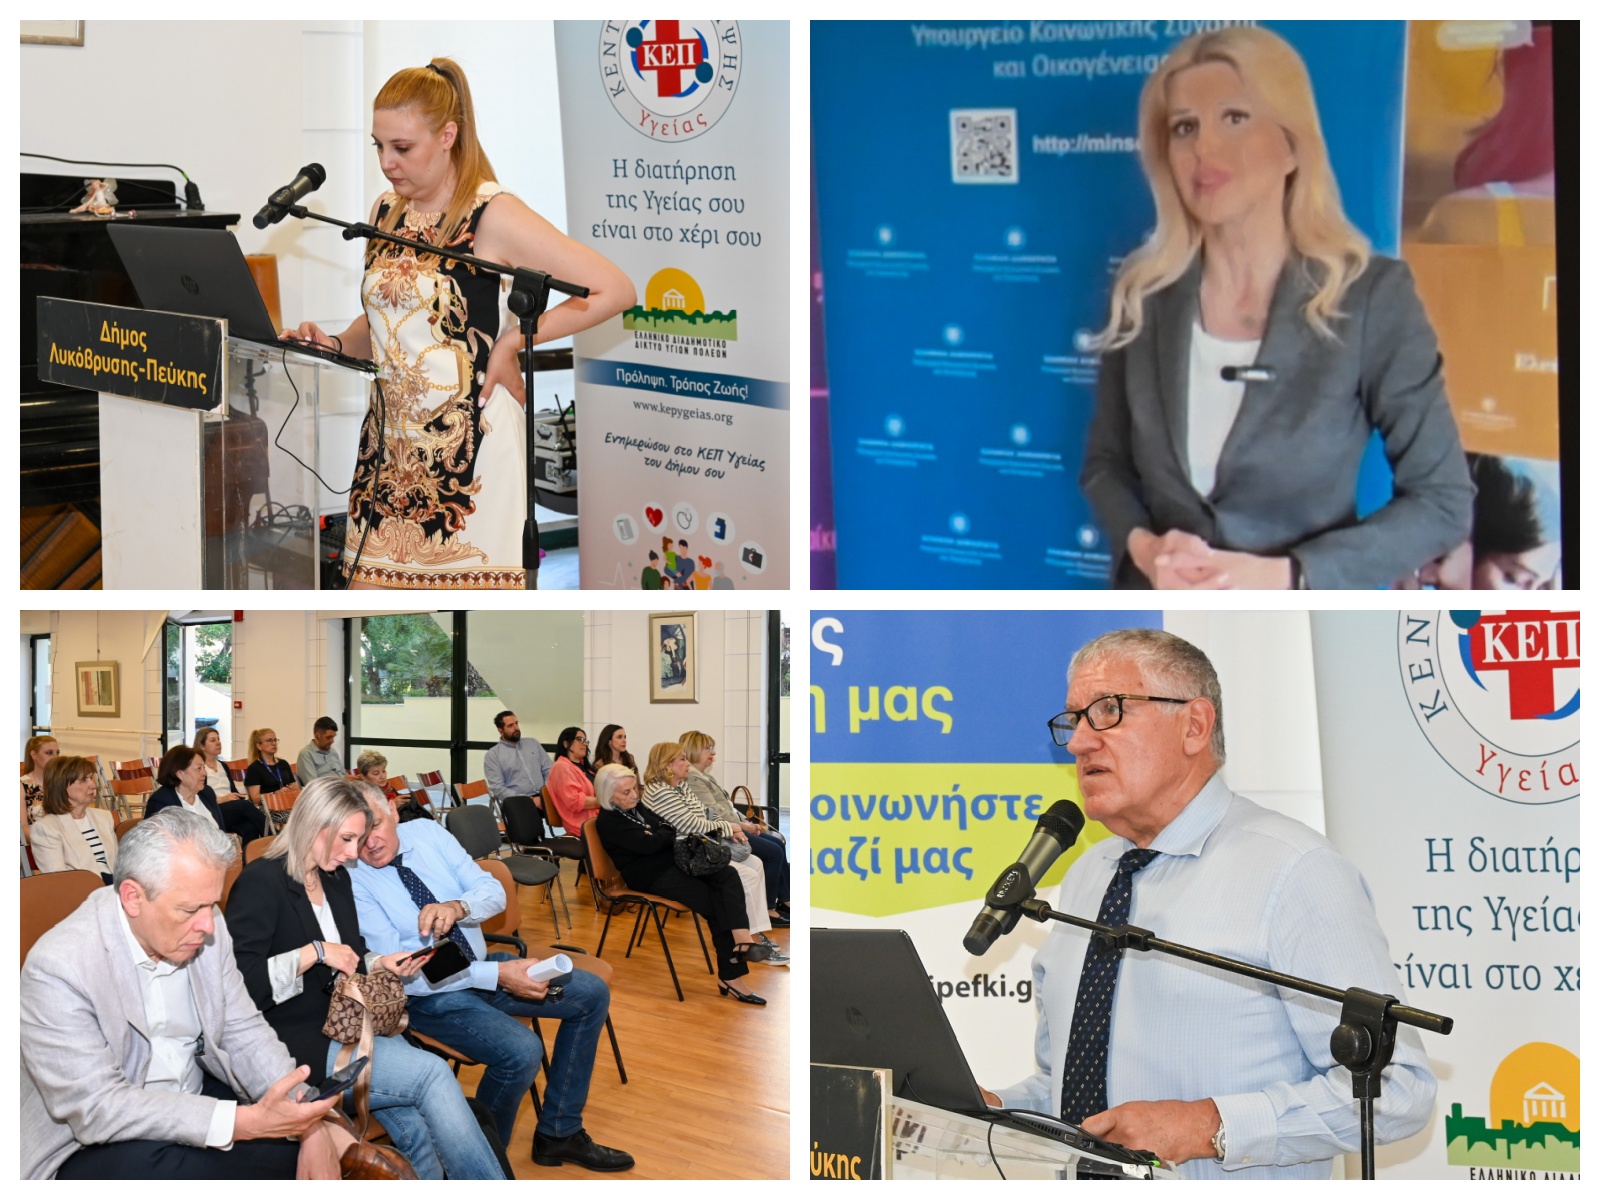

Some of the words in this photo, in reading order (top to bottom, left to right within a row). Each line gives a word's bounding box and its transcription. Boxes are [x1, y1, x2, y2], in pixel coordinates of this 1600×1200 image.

[911, 22, 1025, 51] Υπουργείο
[642, 43, 696, 67] ΚΕΠ
[993, 60, 1026, 78] και
[1032, 51, 1169, 80] Οικογένεια
[639, 110, 707, 136] Υγείας
[612, 159, 628, 178] Η
[634, 158, 736, 185] διατήρηση
[606, 194, 637, 211] της
[643, 190, 702, 215] Υγείας
[709, 197, 745, 213] σου
[592, 219, 637, 240] είναι
[643, 226, 673, 242] στο
[680, 223, 719, 248] χέρι
[726, 230, 762, 247] σου
[100, 320, 147, 352] Δήμος
[634, 330, 670, 342] ΕΛΛΗΝΙΚΟ
[635, 341, 662, 351] ΔΙΚΤΥΟ
[50, 342, 207, 394] Λυκόβρυσης-Πεύκης
[616, 368, 668, 388] Πρόληψη.
[670, 375, 711, 396] Τρόπος
[713, 381, 749, 400] Ζωής!
[633, 400, 733, 426] www.kepygeias.org
[643, 456, 662, 469] του
[665, 458, 700, 477] Δήμου
[704, 467, 726, 479] σου
[674, 446, 693, 457] στο
[697, 447, 724, 462] ΚΕΠ
[727, 450, 766, 472] Υγείας
[1480, 619, 1580, 663] ΚΕΠ
[849, 685, 954, 734] μας
[810, 836, 882, 881] αζί
[894, 846, 974, 884] μας
[1425, 838, 1455, 873] Η
[1412, 904, 1473, 937] της
[1483, 895, 1580, 942] Υγεία
[1394, 952, 1473, 989] ίναι
[1485, 964, 1542, 991] στο
[1553, 965, 1580, 991] χ
